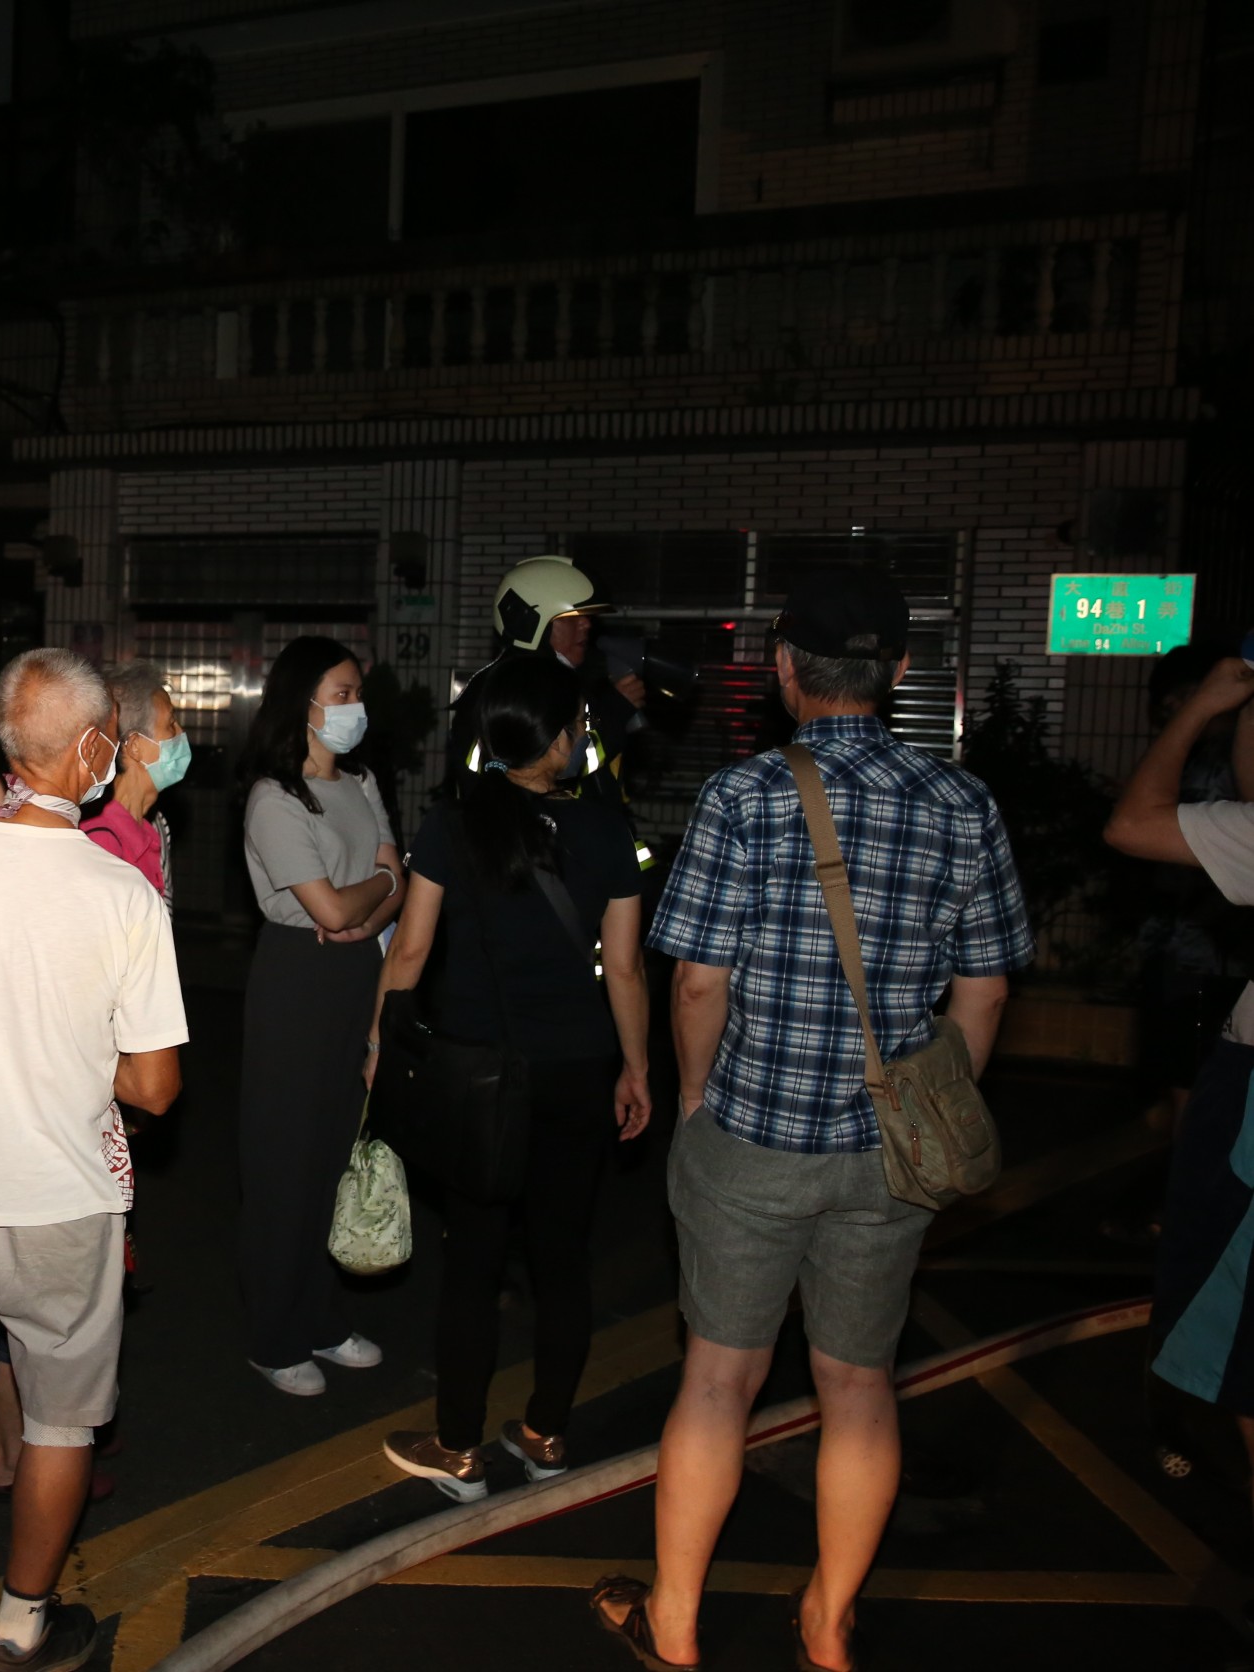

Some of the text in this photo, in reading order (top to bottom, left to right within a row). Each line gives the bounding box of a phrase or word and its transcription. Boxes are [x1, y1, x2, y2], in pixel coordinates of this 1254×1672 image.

[1093, 622, 1128, 635] DaZhi
[397, 633, 430, 659] 29
[1095, 638, 1110, 650] 94
[1156, 641, 1162, 653] 1
